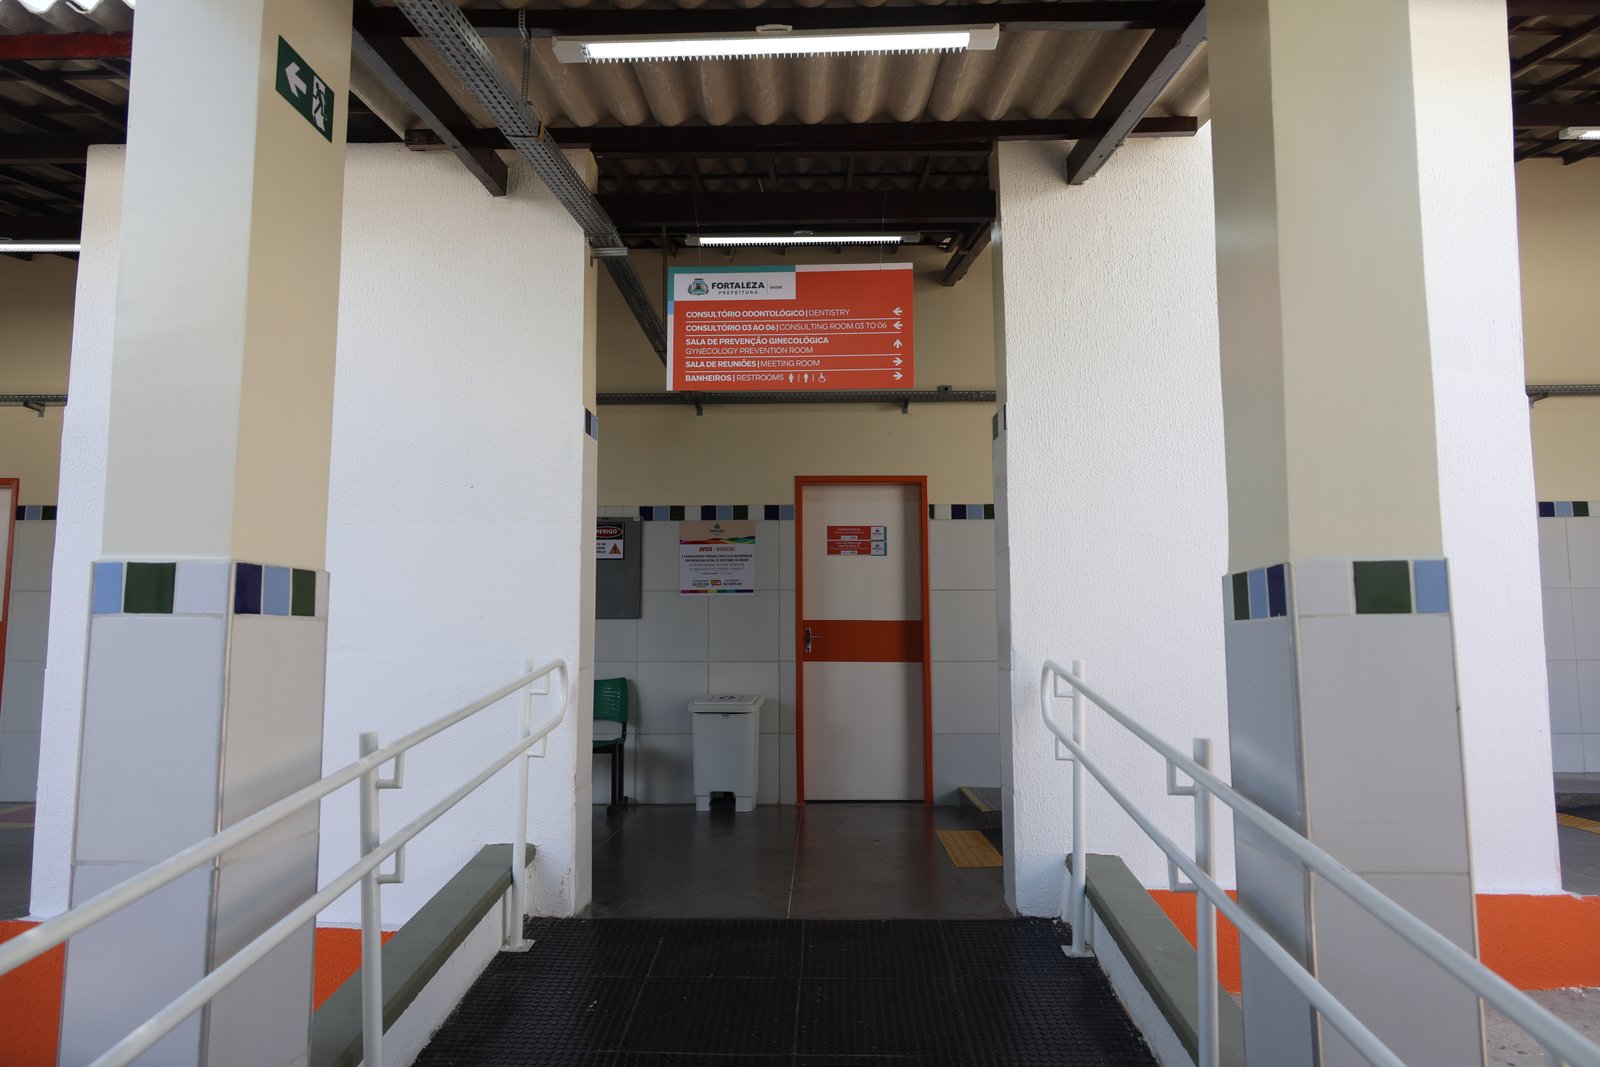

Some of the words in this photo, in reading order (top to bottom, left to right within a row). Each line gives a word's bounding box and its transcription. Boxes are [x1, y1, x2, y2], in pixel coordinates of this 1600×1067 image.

[711, 281, 765, 289] FORTALEZA
[742, 309, 805, 318] ODONTOLÓGICO
[686, 324, 740, 332] CONSULTÓRIO
[719, 336, 767, 346] PREVENÇÃO
[769, 336, 829, 344] GINECOLÓGICA
[717, 358, 756, 368] REUNIÕES
